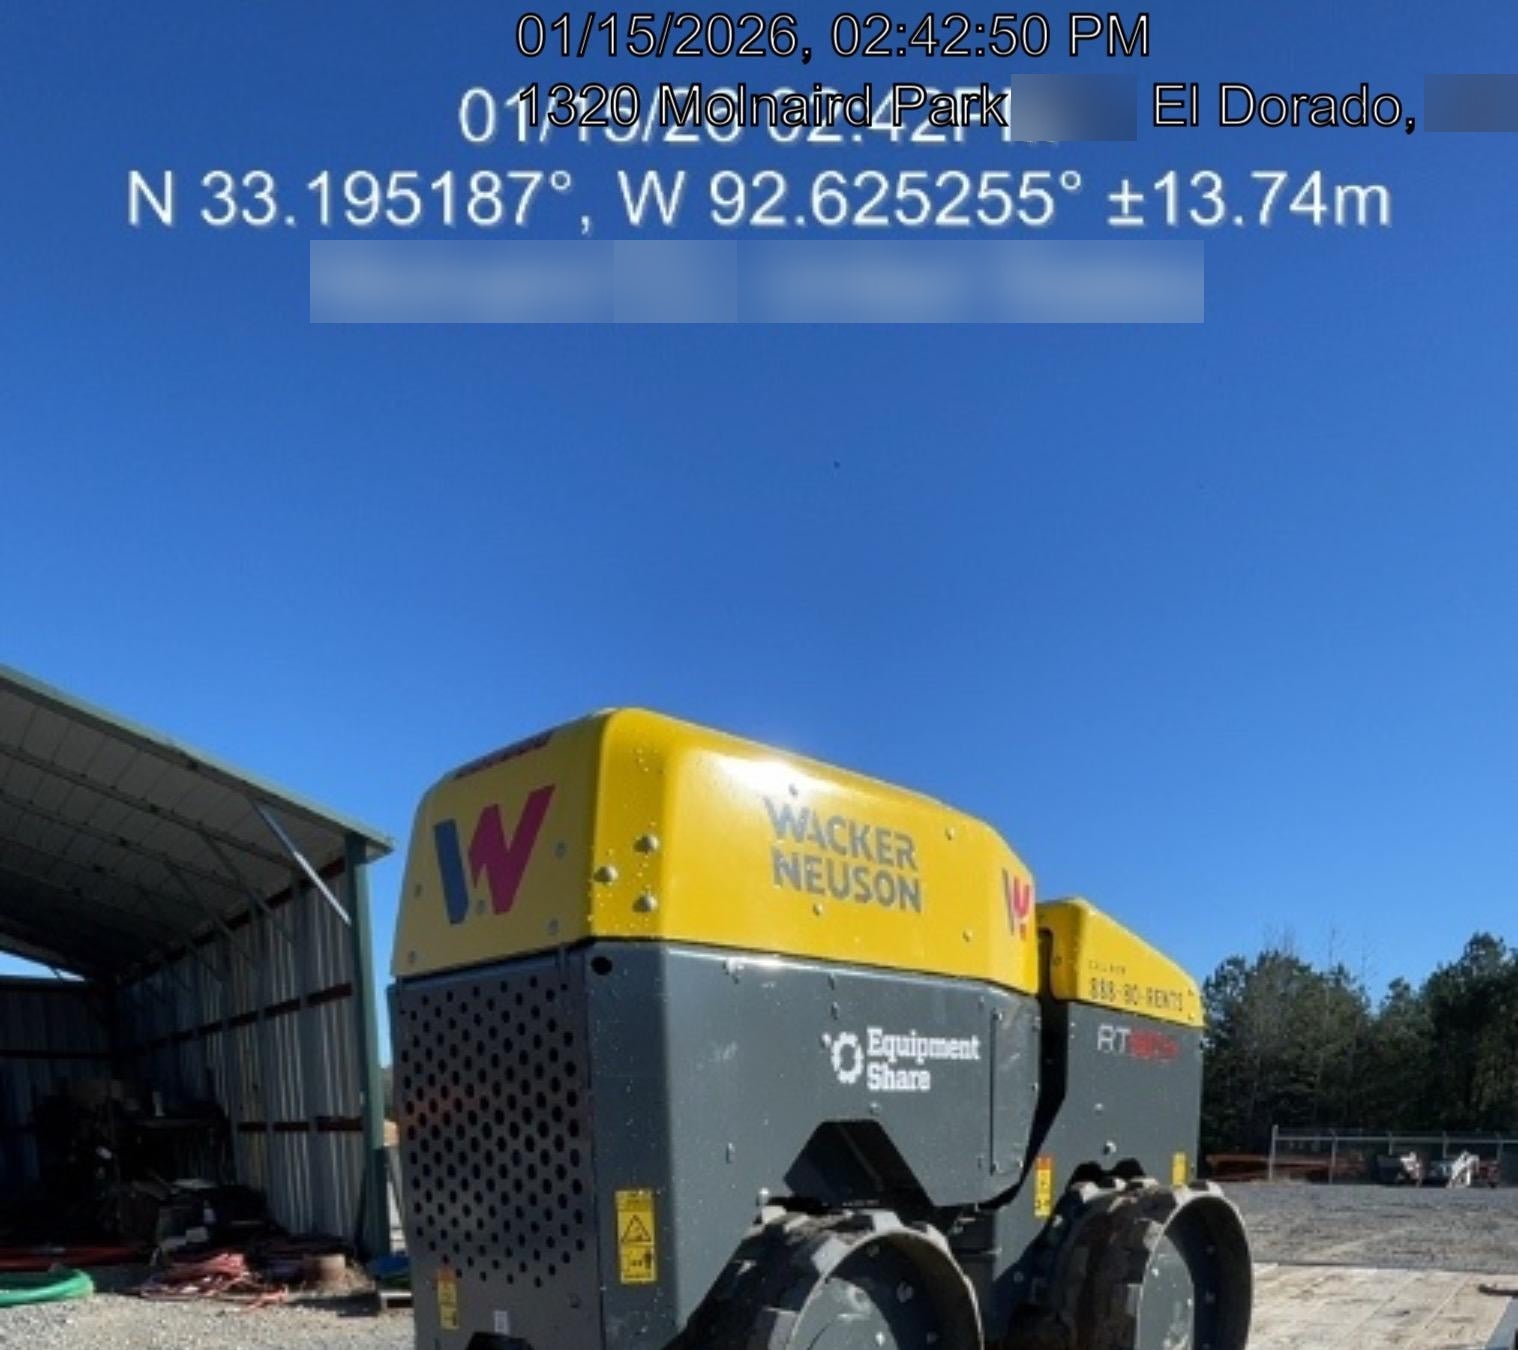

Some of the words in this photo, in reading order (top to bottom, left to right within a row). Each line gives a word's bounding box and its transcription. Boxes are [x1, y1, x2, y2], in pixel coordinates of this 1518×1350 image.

[763, 795, 918, 871] WACKER
[769, 845, 922, 913] NEUSON
[866, 1025, 981, 1065] Equipment
[866, 1061, 931, 1092] Share
